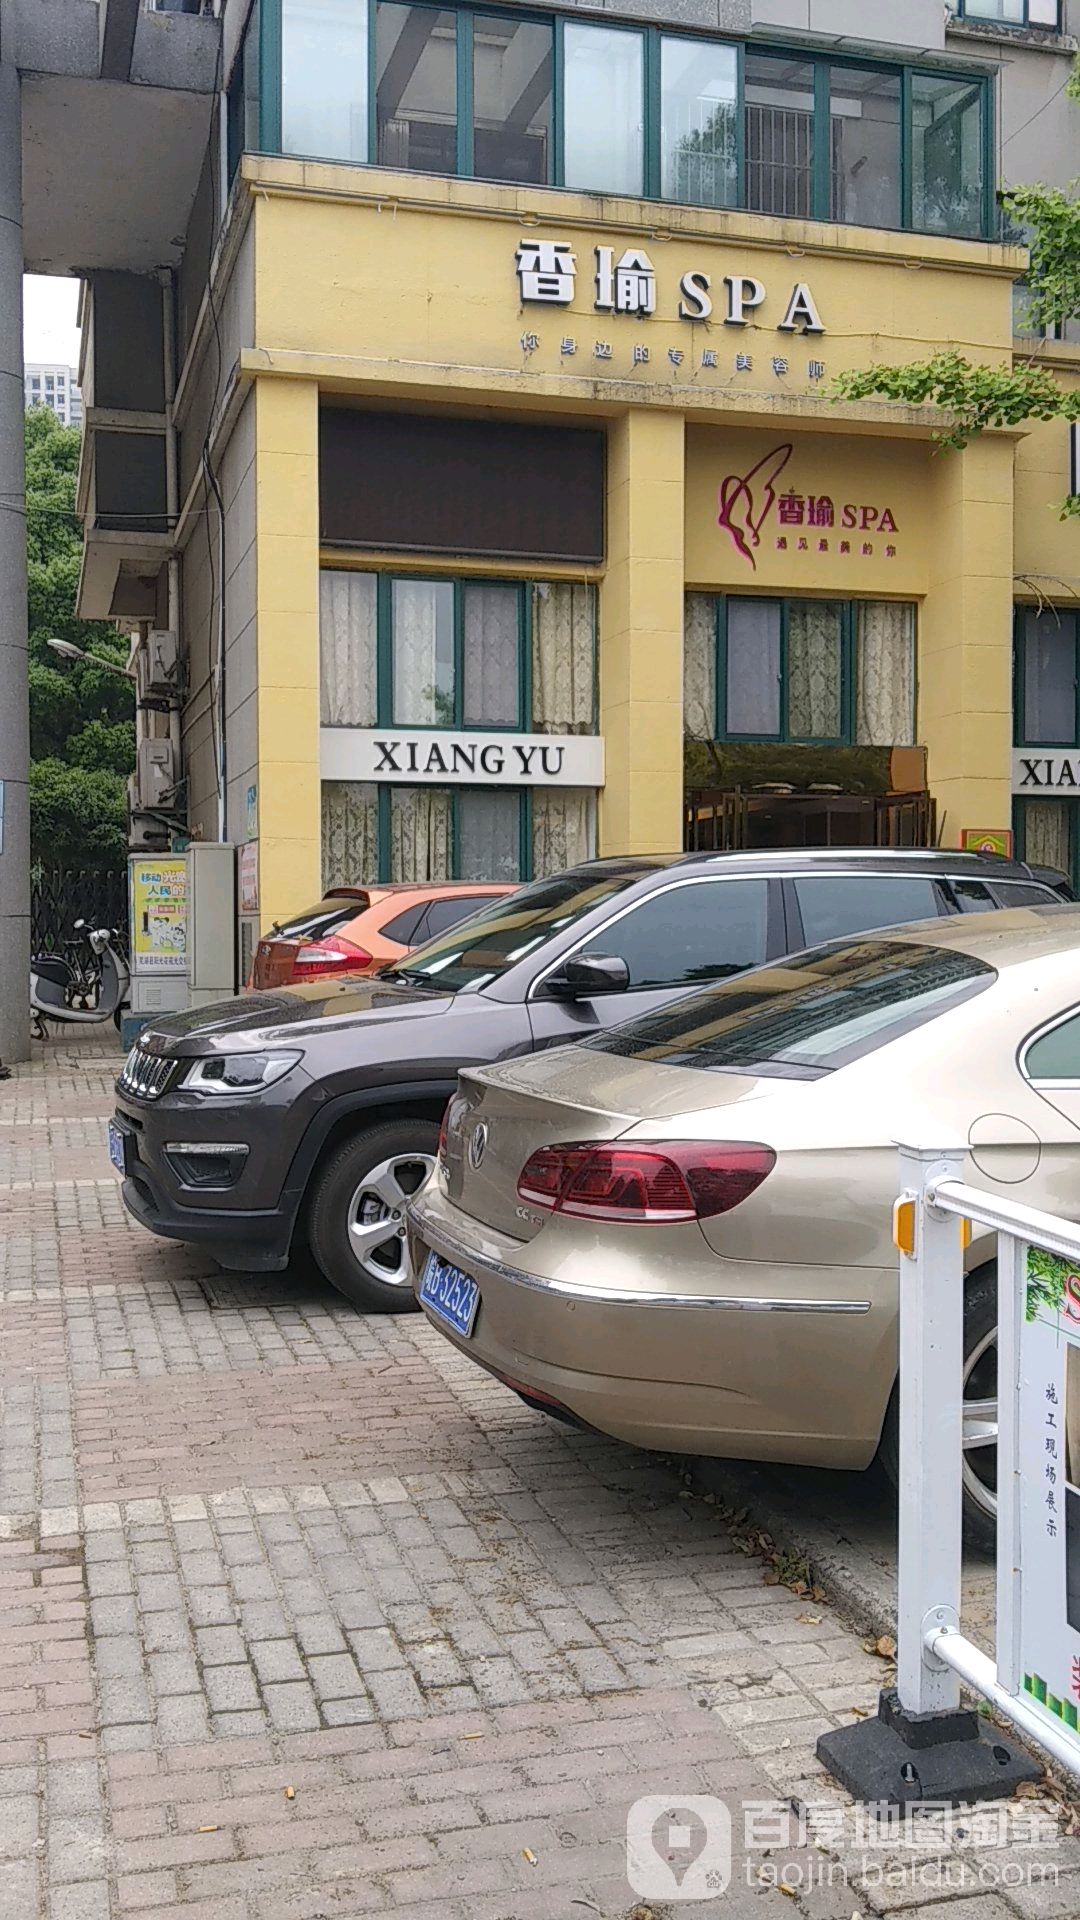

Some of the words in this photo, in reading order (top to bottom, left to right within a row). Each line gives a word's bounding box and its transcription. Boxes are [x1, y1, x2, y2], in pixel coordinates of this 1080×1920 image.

[516, 239, 657, 316] 香瑜
[679, 270, 827, 333] SPA
[520, 331, 826, 379] 你身边的专属美容师
[778, 494, 834, 528] 香瑜
[841, 504, 899, 533] SPA
[776, 536, 897, 558] 遇见最美的你
[1019, 758, 1080, 787] XIA
[1045, 1383, 1058, 1537] 施工现场展示
